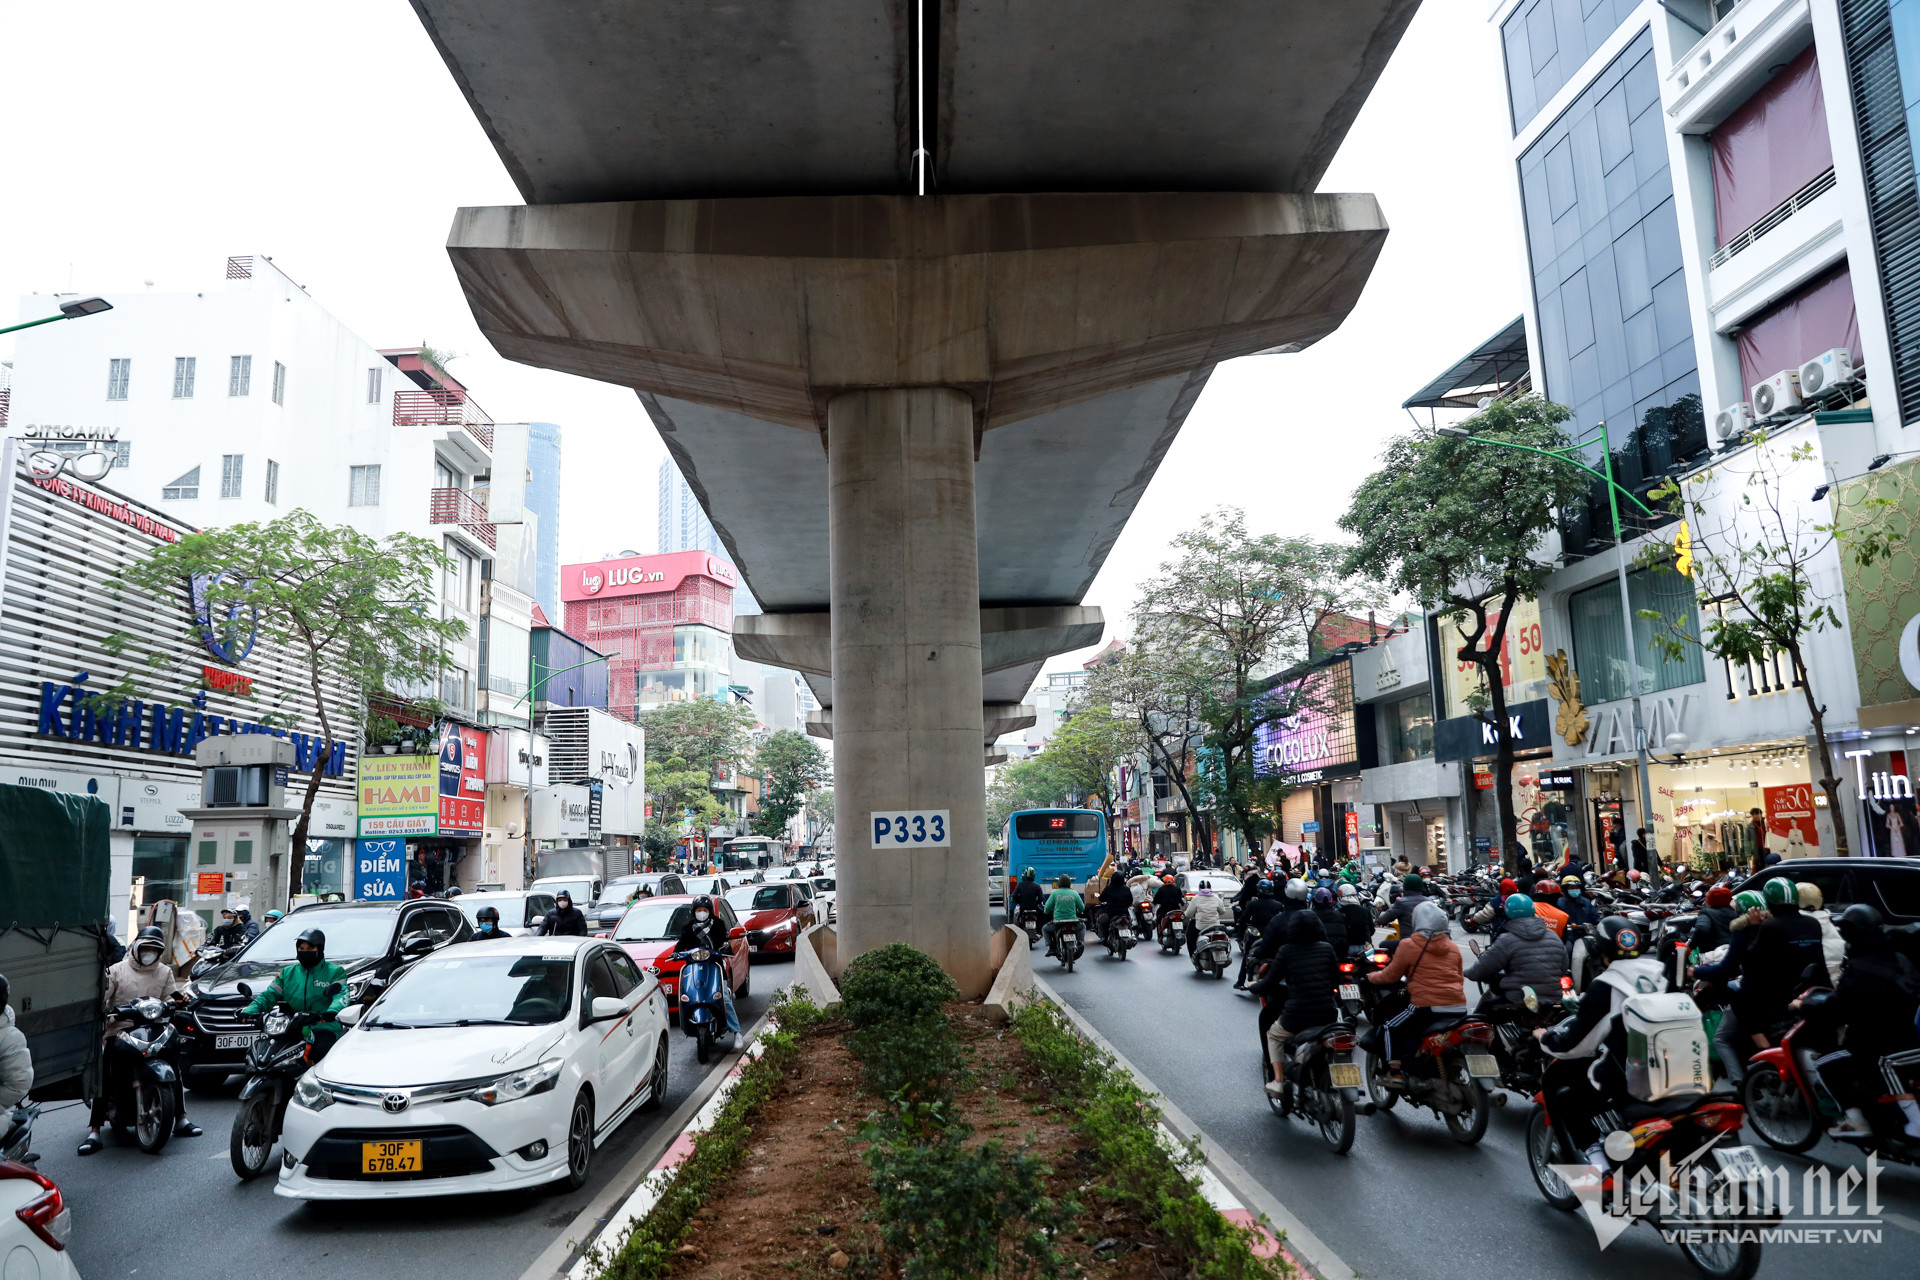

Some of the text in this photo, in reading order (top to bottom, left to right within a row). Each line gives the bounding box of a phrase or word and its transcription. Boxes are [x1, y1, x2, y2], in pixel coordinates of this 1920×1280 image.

[70, 485, 86, 504] TY
[85, 493, 112, 516] KÍNH
[112, 503, 134, 526] MẮT
[154, 523, 177, 544] NAM
[608, 567, 664, 587] LUG.vn
[1520, 623, 1542, 655] 50
[1266, 730, 1331, 769] COCOLUX
[376, 761, 431, 772] LIÊN THÀNH
[1845, 749, 1915, 800] Tiin
[1554, 776, 1573, 784] KRIK
[364, 785, 431, 804] HAMI
[1658, 786, 1674, 798] SALE
[368, 817, 427, 829] 159 CẦU GIẤY
[874, 815, 945, 844] P333
[1603, 819, 1613, 861] SALE
[360, 852, 400, 873] ĐIỂM
[363, 878, 396, 897] SỬA
[1692, 1058, 1703, 1089] YONEX
[379, 1143, 405, 1156] 30F
[368, 1157, 415, 1171] 678.47
